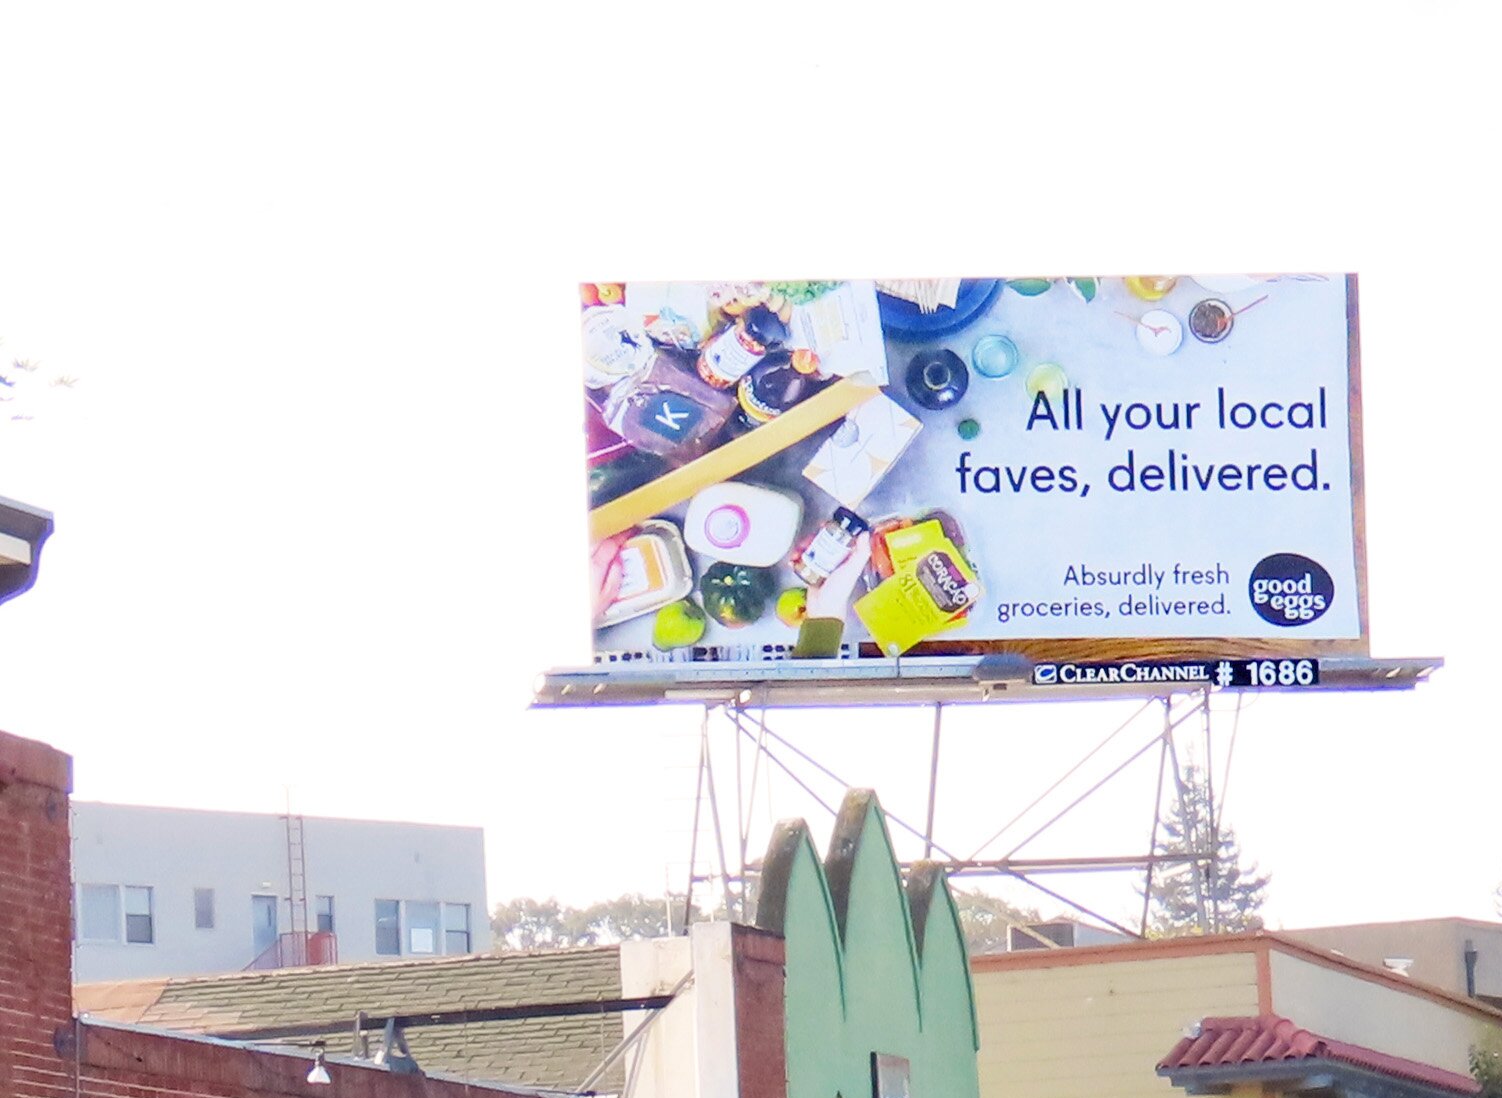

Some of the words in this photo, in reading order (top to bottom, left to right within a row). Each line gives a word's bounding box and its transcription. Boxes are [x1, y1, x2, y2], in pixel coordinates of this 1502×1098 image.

[655, 402, 689, 431] K
[1025, 387, 1084, 431] All
[1100, 402, 1201, 441] your
[1216, 386, 1328, 430] local
[955, 451, 1091, 498] faves,
[1107, 448, 1331, 493] delivered.
[1063, 563, 1166, 589] Absurdly
[1172, 562, 1230, 585] fresh
[1252, 572, 1312, 604] good
[997, 600, 1111, 624] groceries,
[1118, 593, 1232, 616] delivered.
[1270, 594, 1326, 620] eggs
[1246, 659, 1314, 687] 1686
